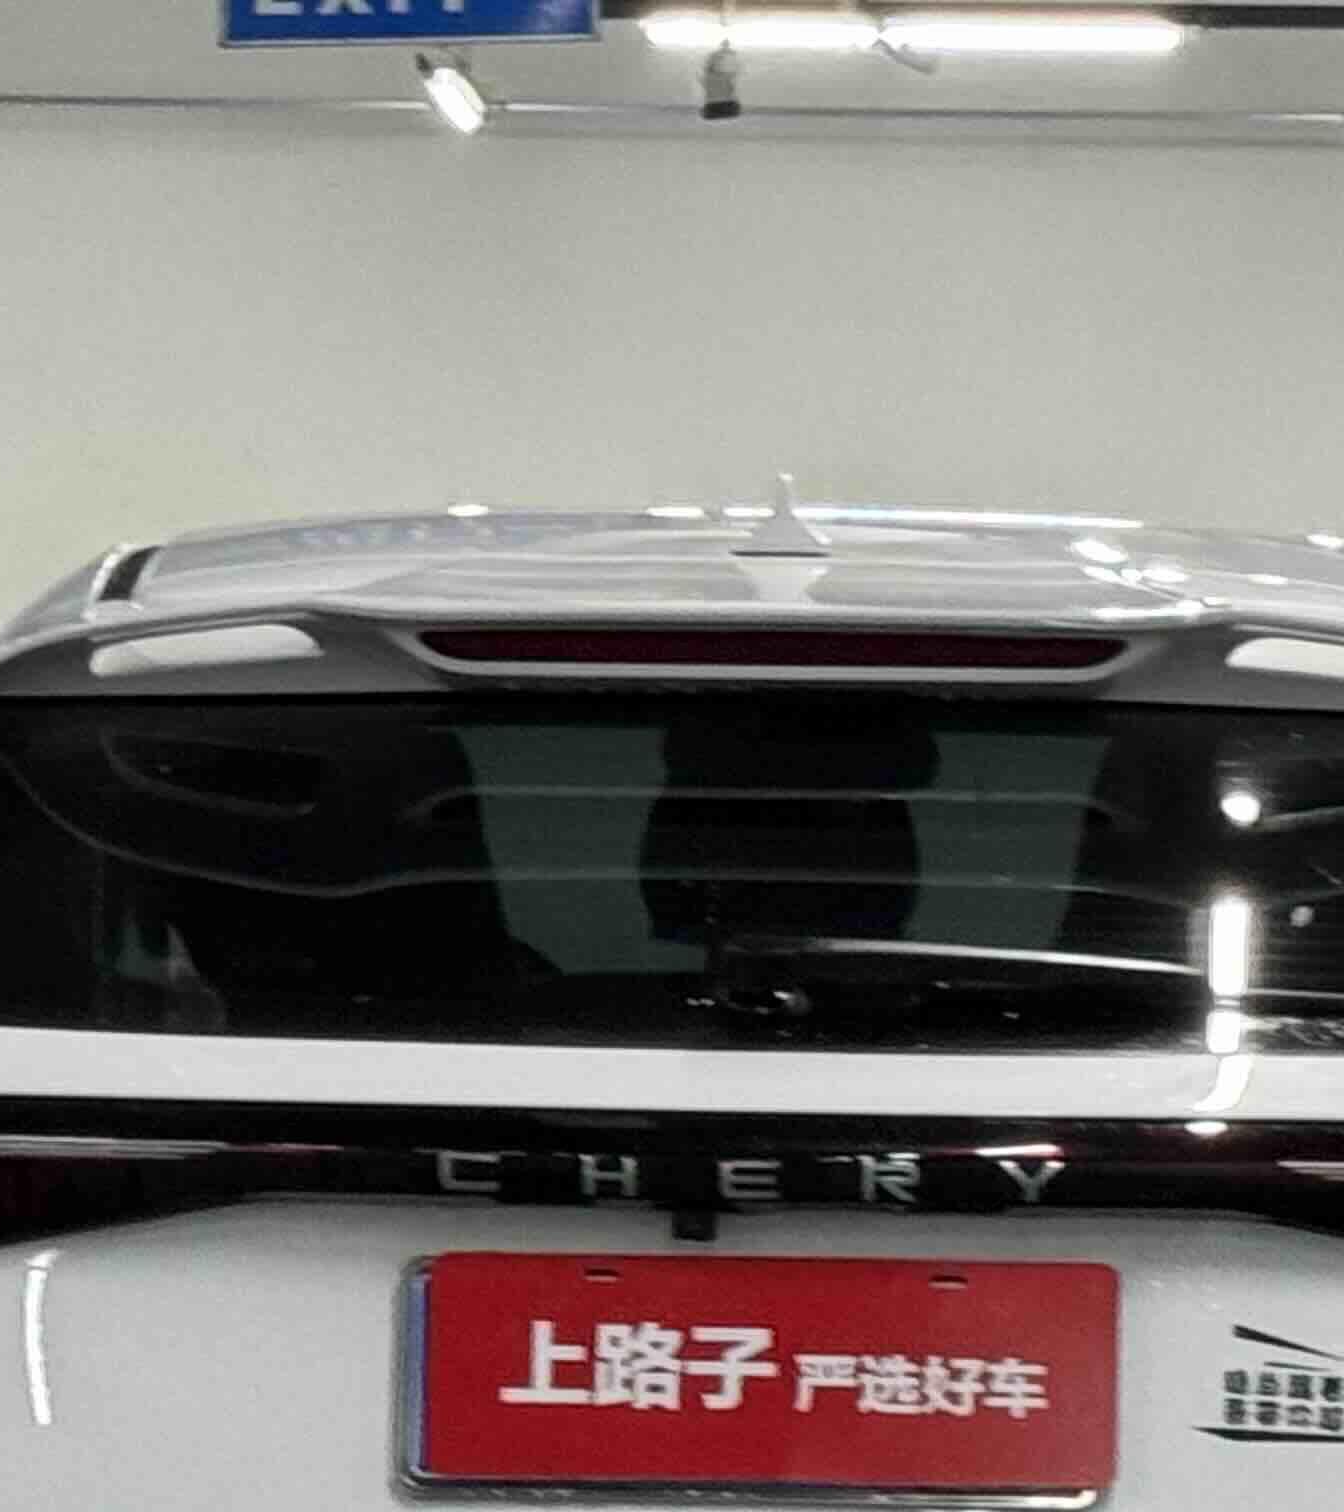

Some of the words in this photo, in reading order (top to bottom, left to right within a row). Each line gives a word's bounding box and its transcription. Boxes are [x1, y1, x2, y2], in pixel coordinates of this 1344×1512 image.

[438, 1150, 1064, 1203] CHERY
[498, 1320, 779, 1412] 上路子
[794, 1353, 1049, 1418] 严选好车
